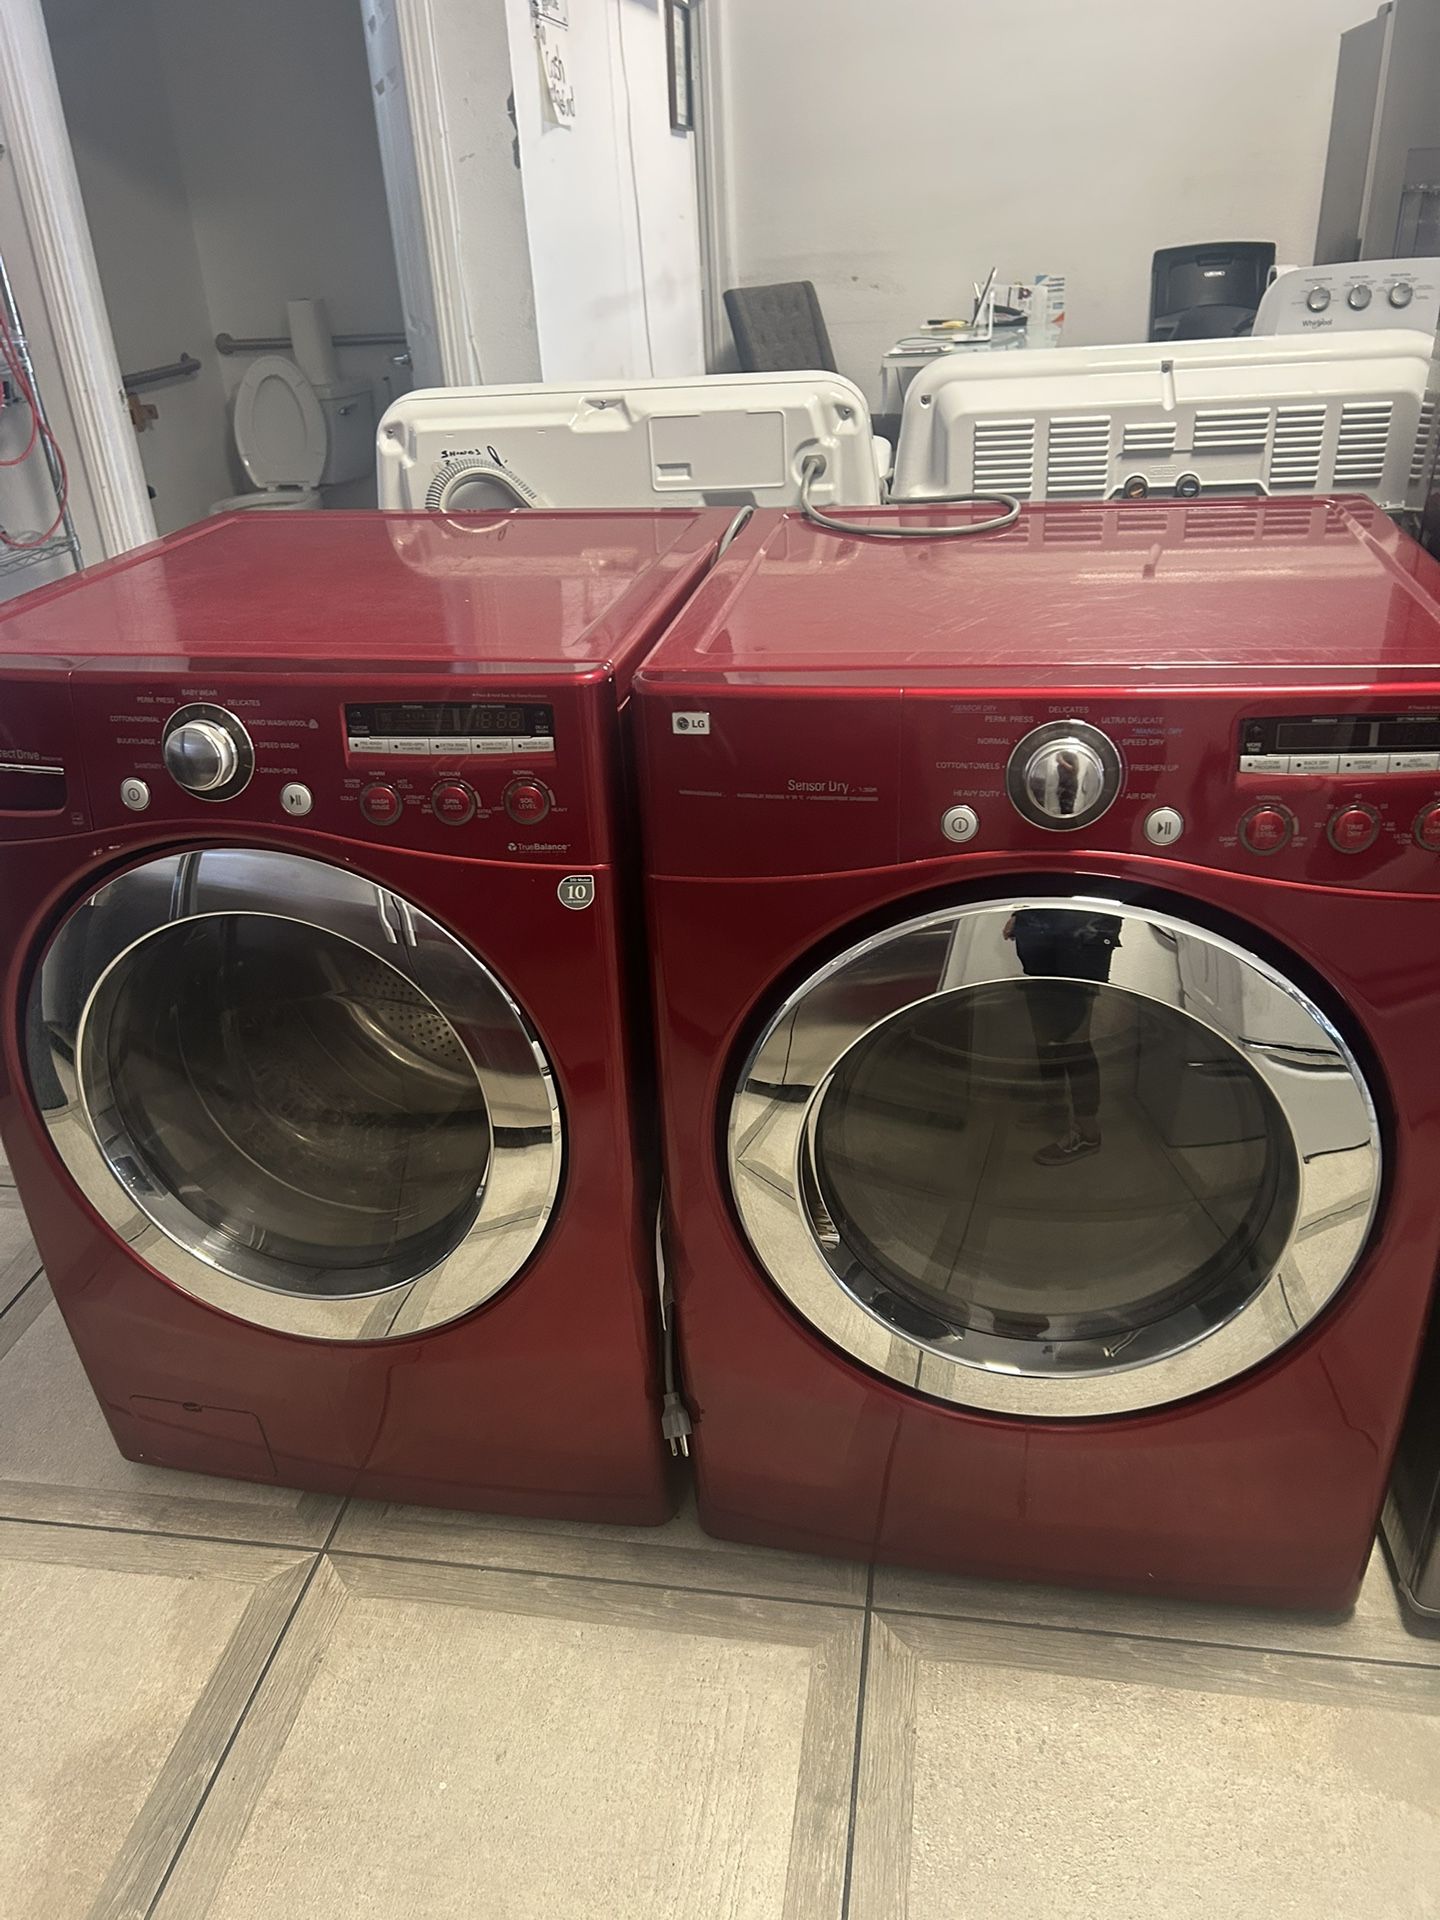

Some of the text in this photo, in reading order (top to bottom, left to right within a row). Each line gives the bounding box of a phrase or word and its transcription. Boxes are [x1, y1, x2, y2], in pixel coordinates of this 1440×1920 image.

[1302, 318, 1333, 329] Whirlpool
[691, 719, 705, 729] LG
[1101, 716, 1126, 724] ULTRA
[17, 750, 40, 760] Drive
[935, 762, 1001, 770] COTTON/TOWELS
[787, 779, 826, 792] Sensor
[828, 781, 849, 794] Dry
[953, 789, 978, 797] HEAVY
[1126, 792, 1157, 800] AIR DRY
[567, 885, 587, 899] 10
